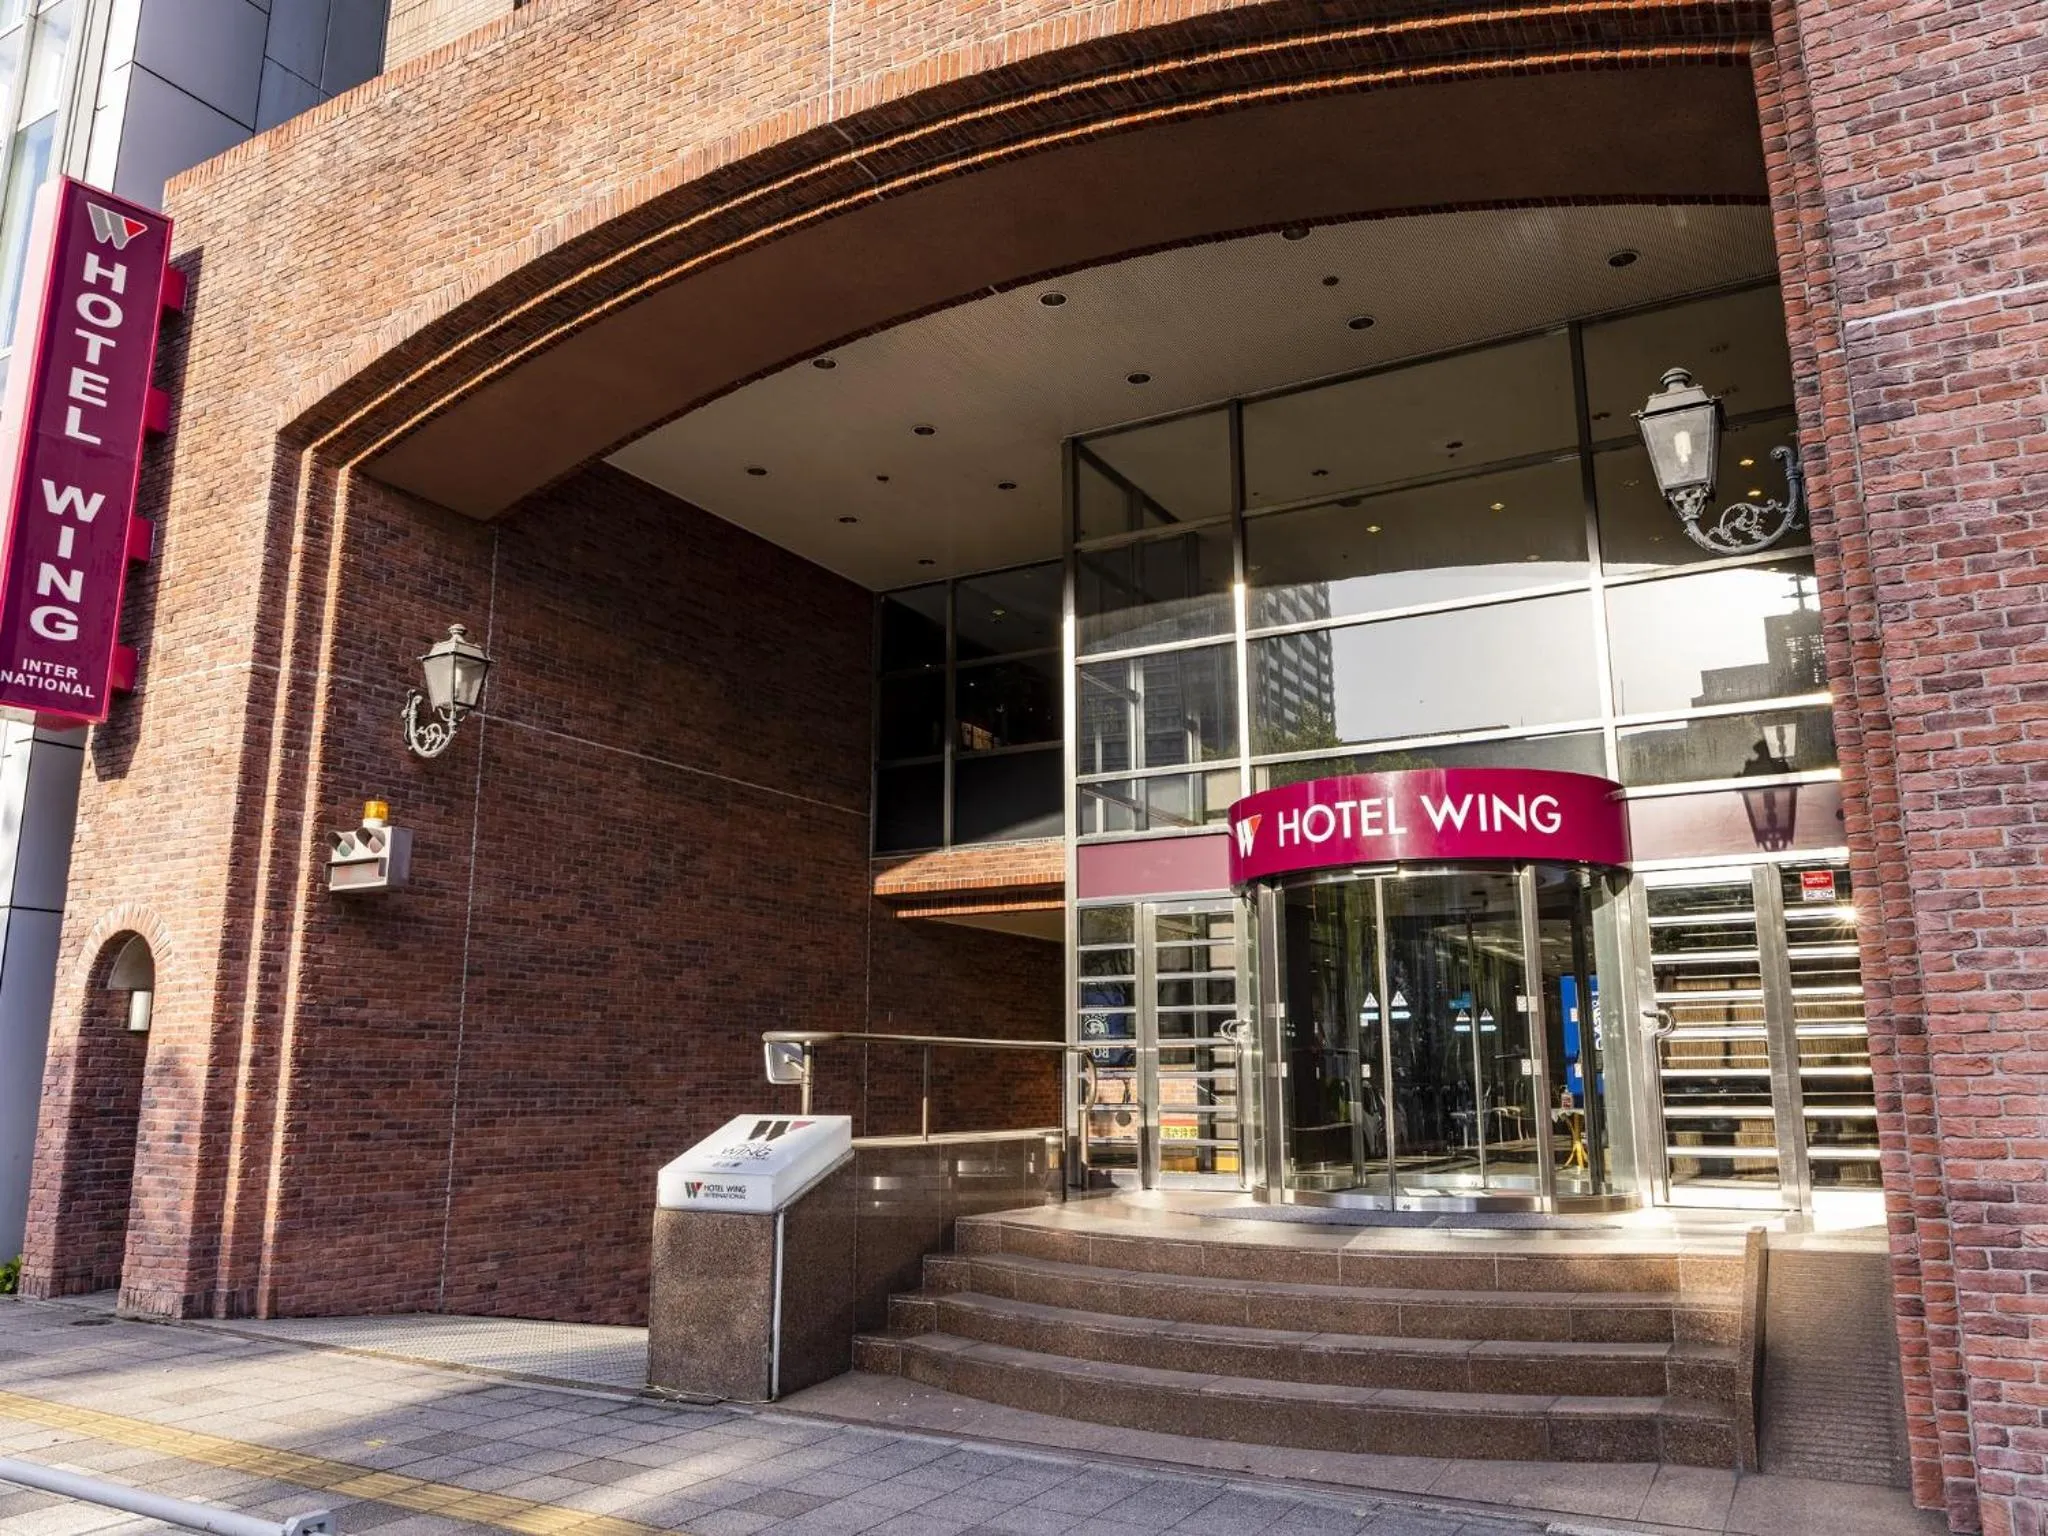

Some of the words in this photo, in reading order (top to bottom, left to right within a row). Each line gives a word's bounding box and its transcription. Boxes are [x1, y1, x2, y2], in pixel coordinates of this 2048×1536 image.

[65, 253, 127, 445] HOTEL
[29, 477, 106, 642] WING
[0, 669, 95, 699] NATIONAL
[22, 658, 78, 680] INTER
[1278, 797, 1408, 847] HOTEL
[1419, 793, 1562, 835] WING
[704, 1184, 724, 1193] HOTEL
[725, 1184, 747, 1194] WING
